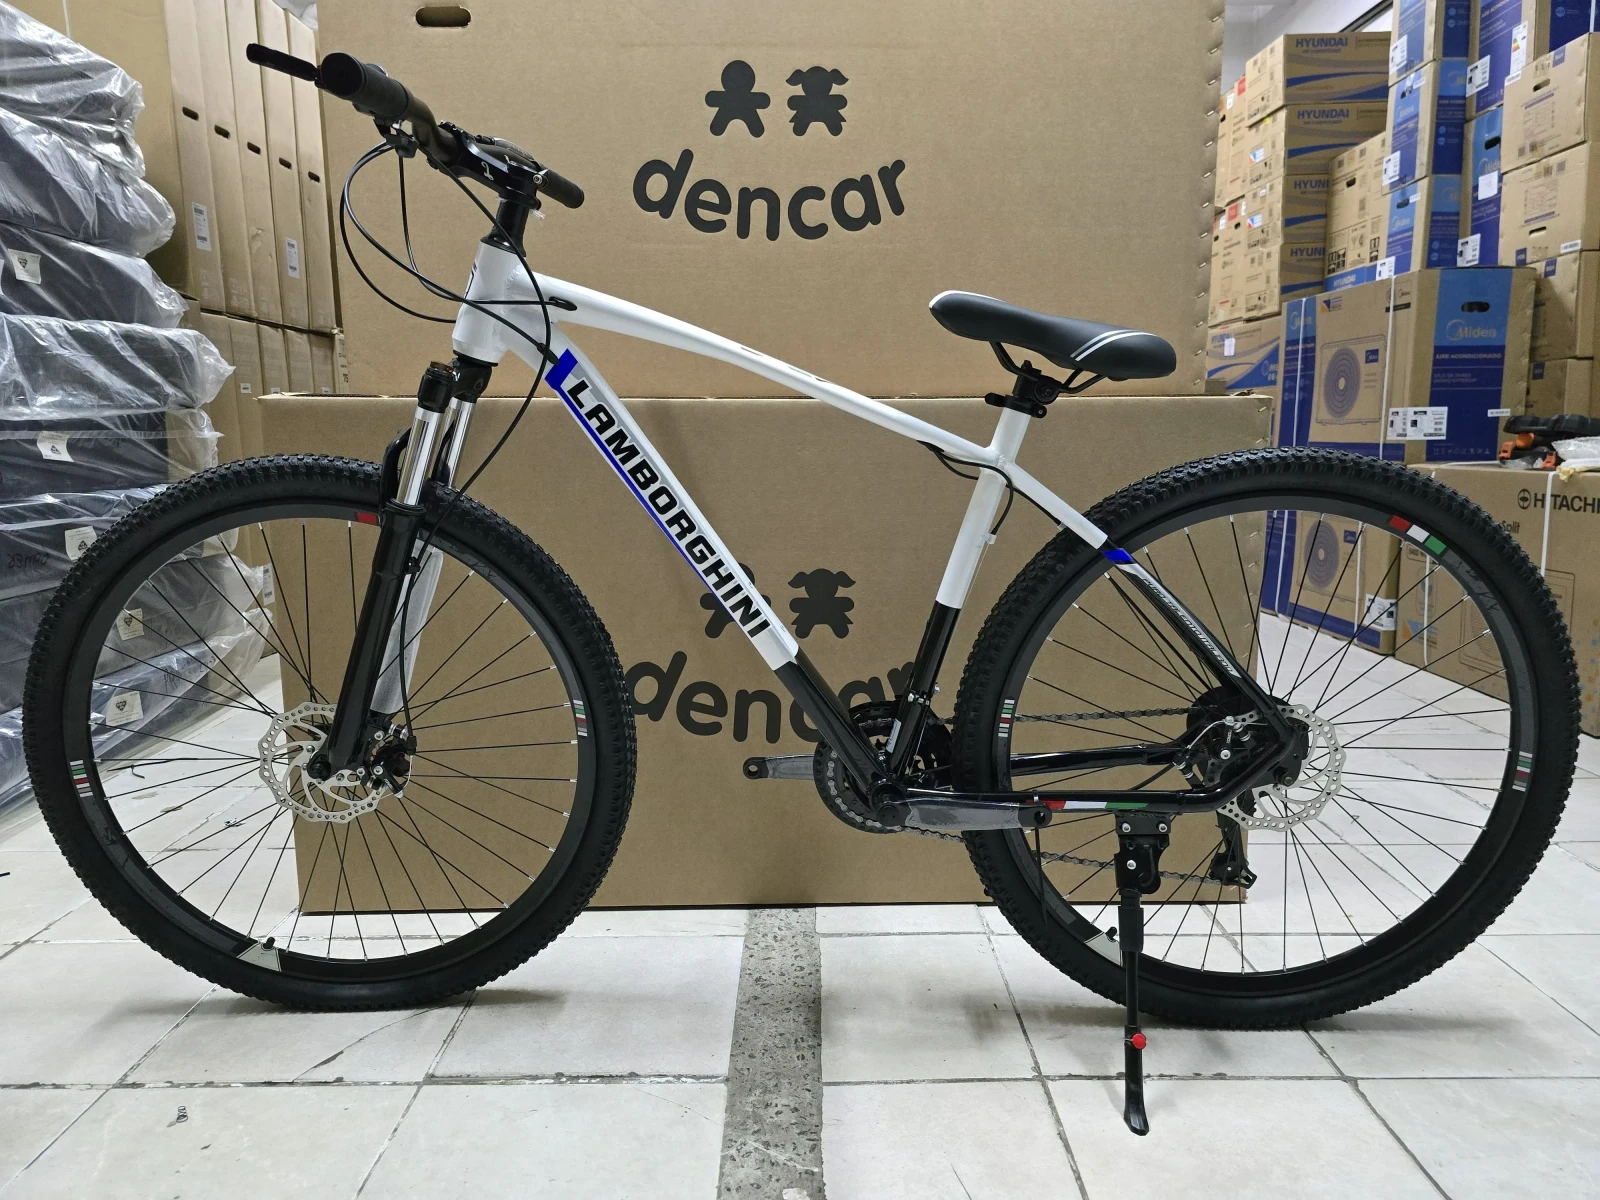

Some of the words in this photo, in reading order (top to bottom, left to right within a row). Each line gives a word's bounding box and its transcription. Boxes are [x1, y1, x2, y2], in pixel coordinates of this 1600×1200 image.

[1296, 37, 1348, 48] HYUNDAI
[1297, 108, 1350, 119] HYUNDAI
[1294, 180, 1329, 190] HYUN
[633, 148, 906, 241] dencar
[1290, 247, 1325, 257] HYUN
[1455, 326, 1497, 338] Midea
[567, 379, 771, 638] LAMBORGHINI
[1533, 493, 1600, 514] HTACHI
